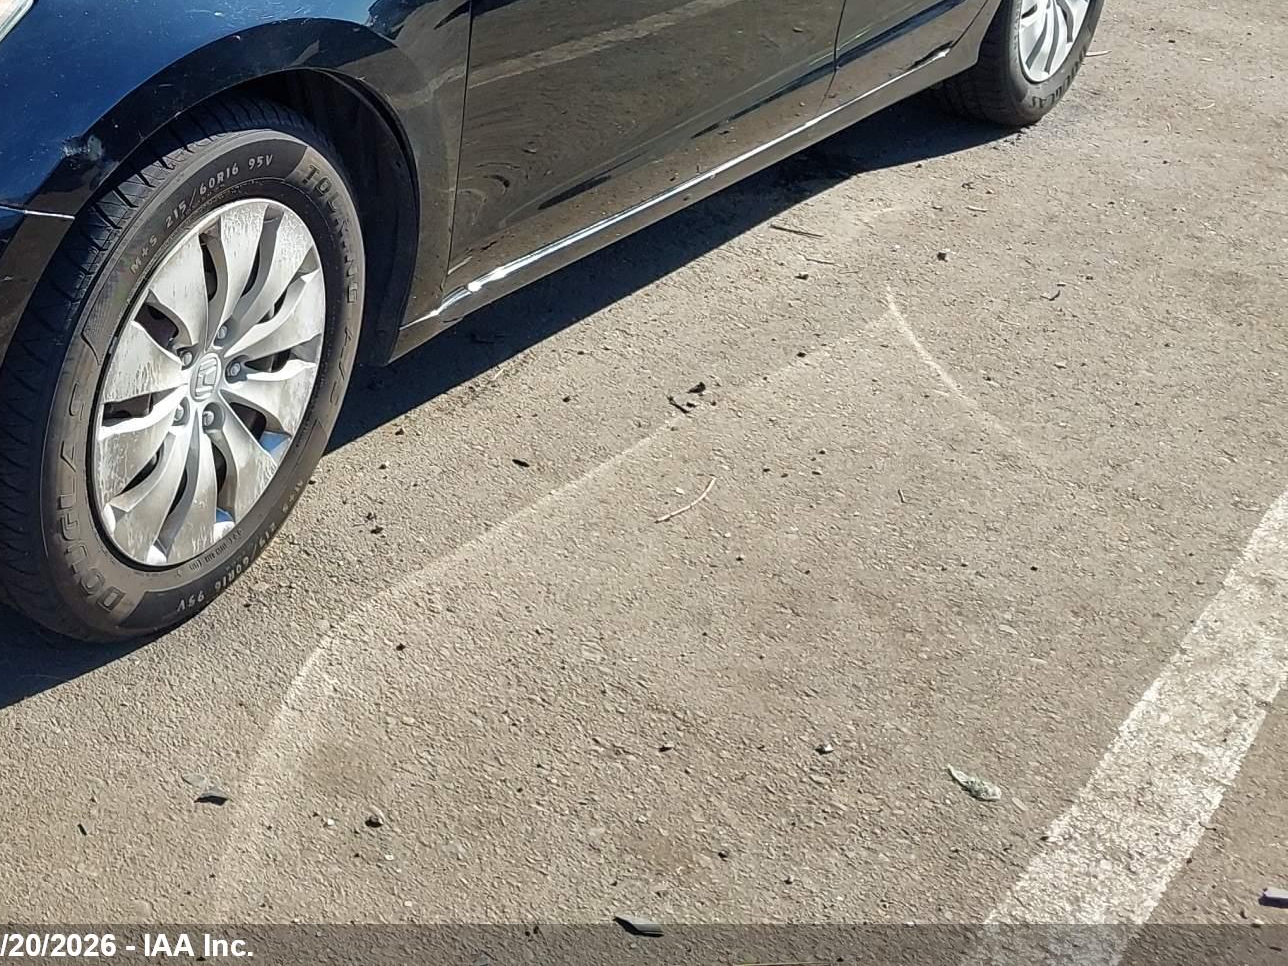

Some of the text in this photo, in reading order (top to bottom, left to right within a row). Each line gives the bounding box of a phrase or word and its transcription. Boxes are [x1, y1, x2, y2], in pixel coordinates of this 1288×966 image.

[165, 163, 240, 229] 215/60R16
[247, 153, 274, 171] 95V
[56, 381, 126, 614] DOUGLAS
[176, 590, 206, 613] 95V
